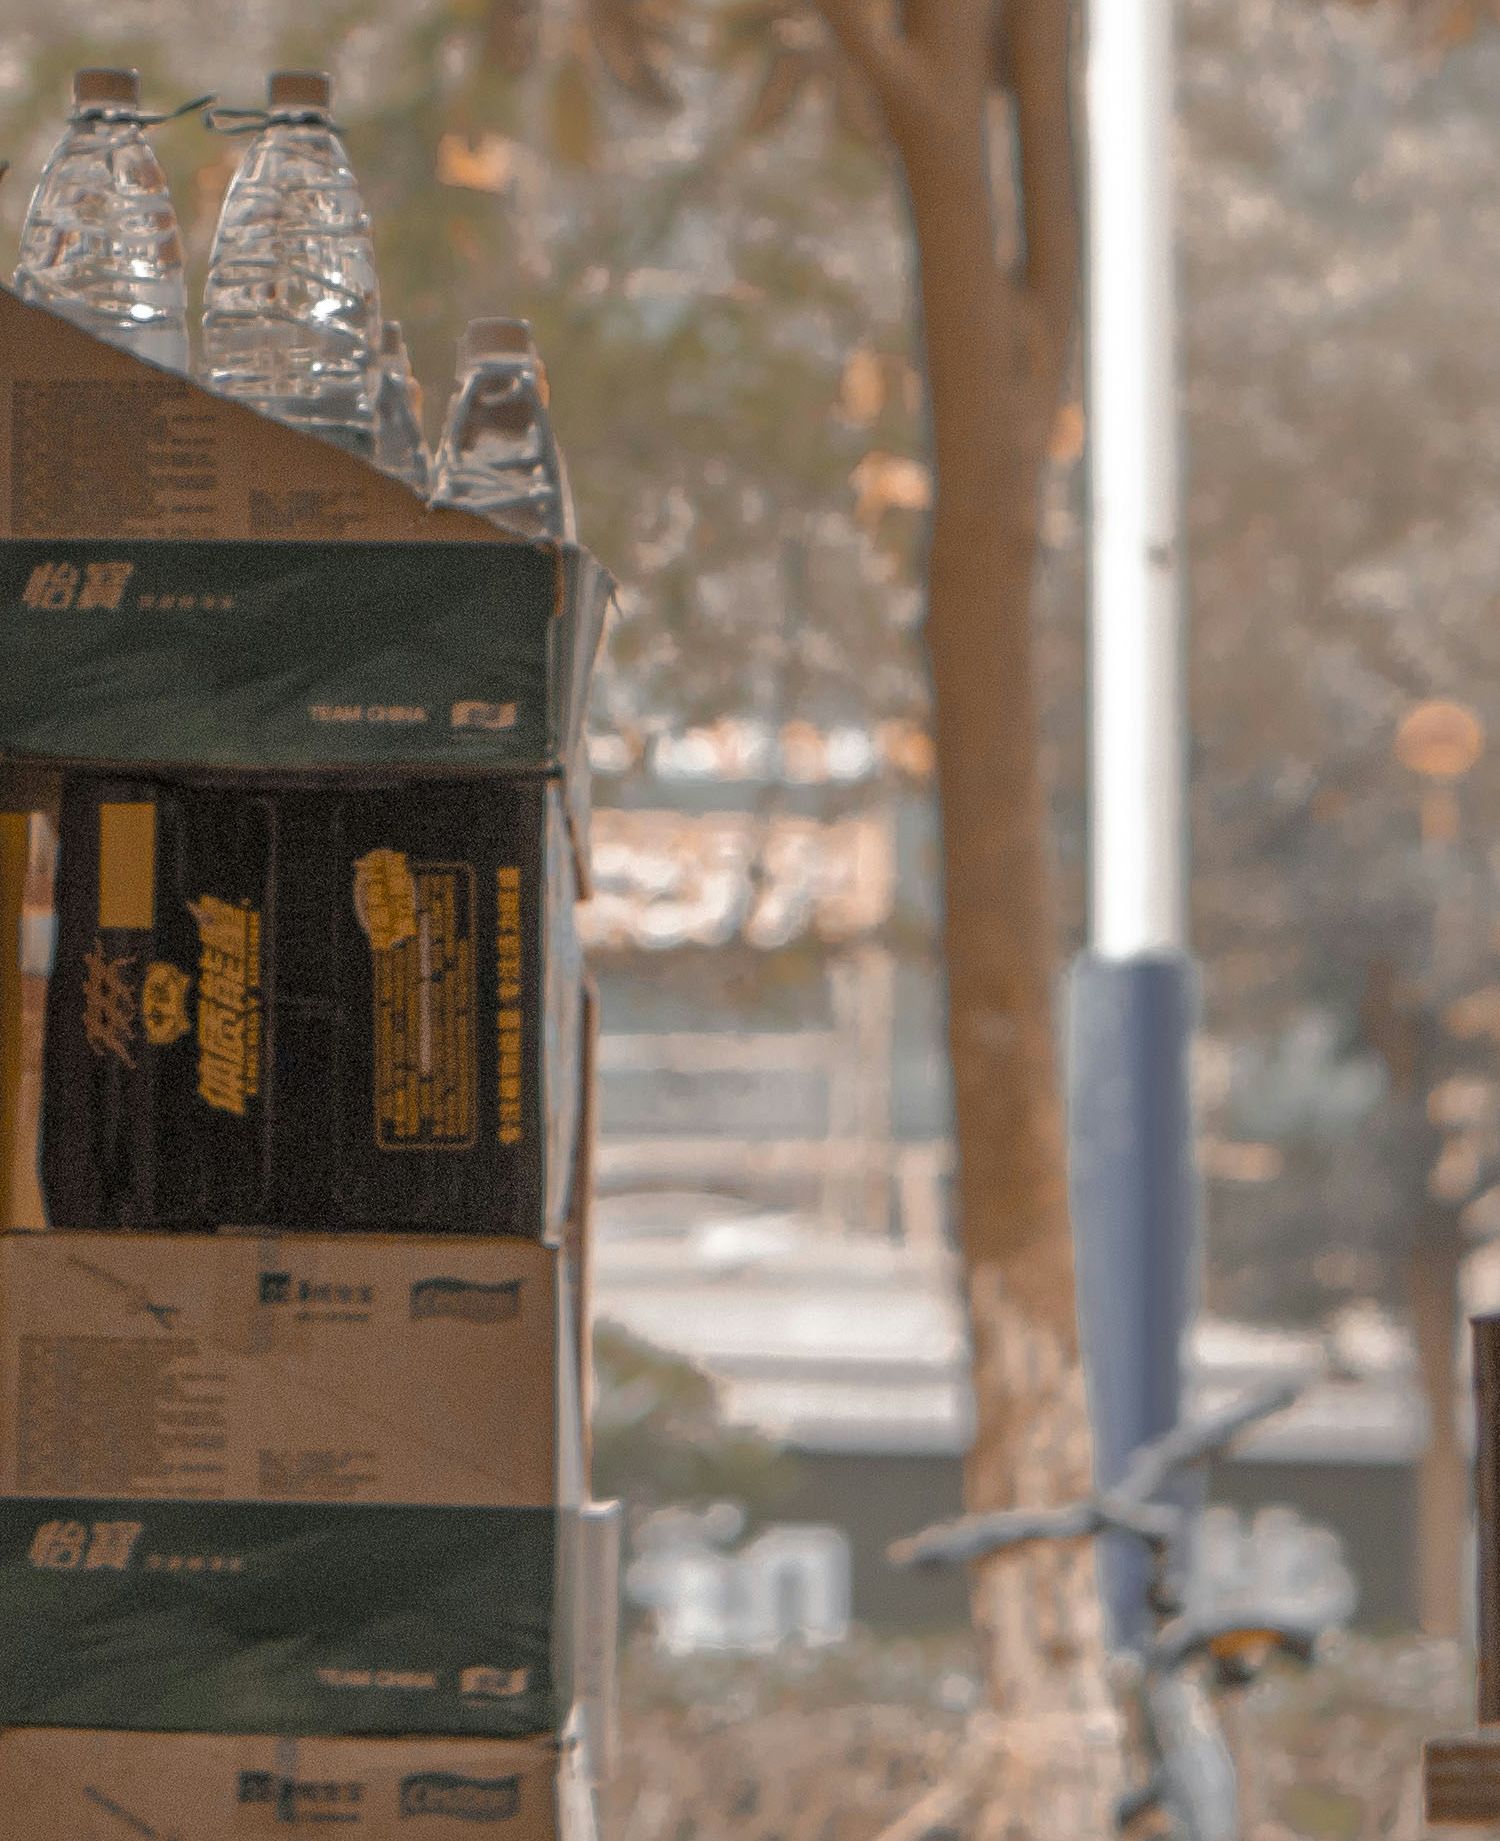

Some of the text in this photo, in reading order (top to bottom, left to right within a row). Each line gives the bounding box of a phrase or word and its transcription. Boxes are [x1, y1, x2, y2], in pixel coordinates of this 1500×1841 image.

[310, 702, 362, 723] TEAM
[367, 703, 428, 723] CHINA
[317, 1667, 370, 1687] TEAM
[374, 1669, 437, 1689] CHINA
